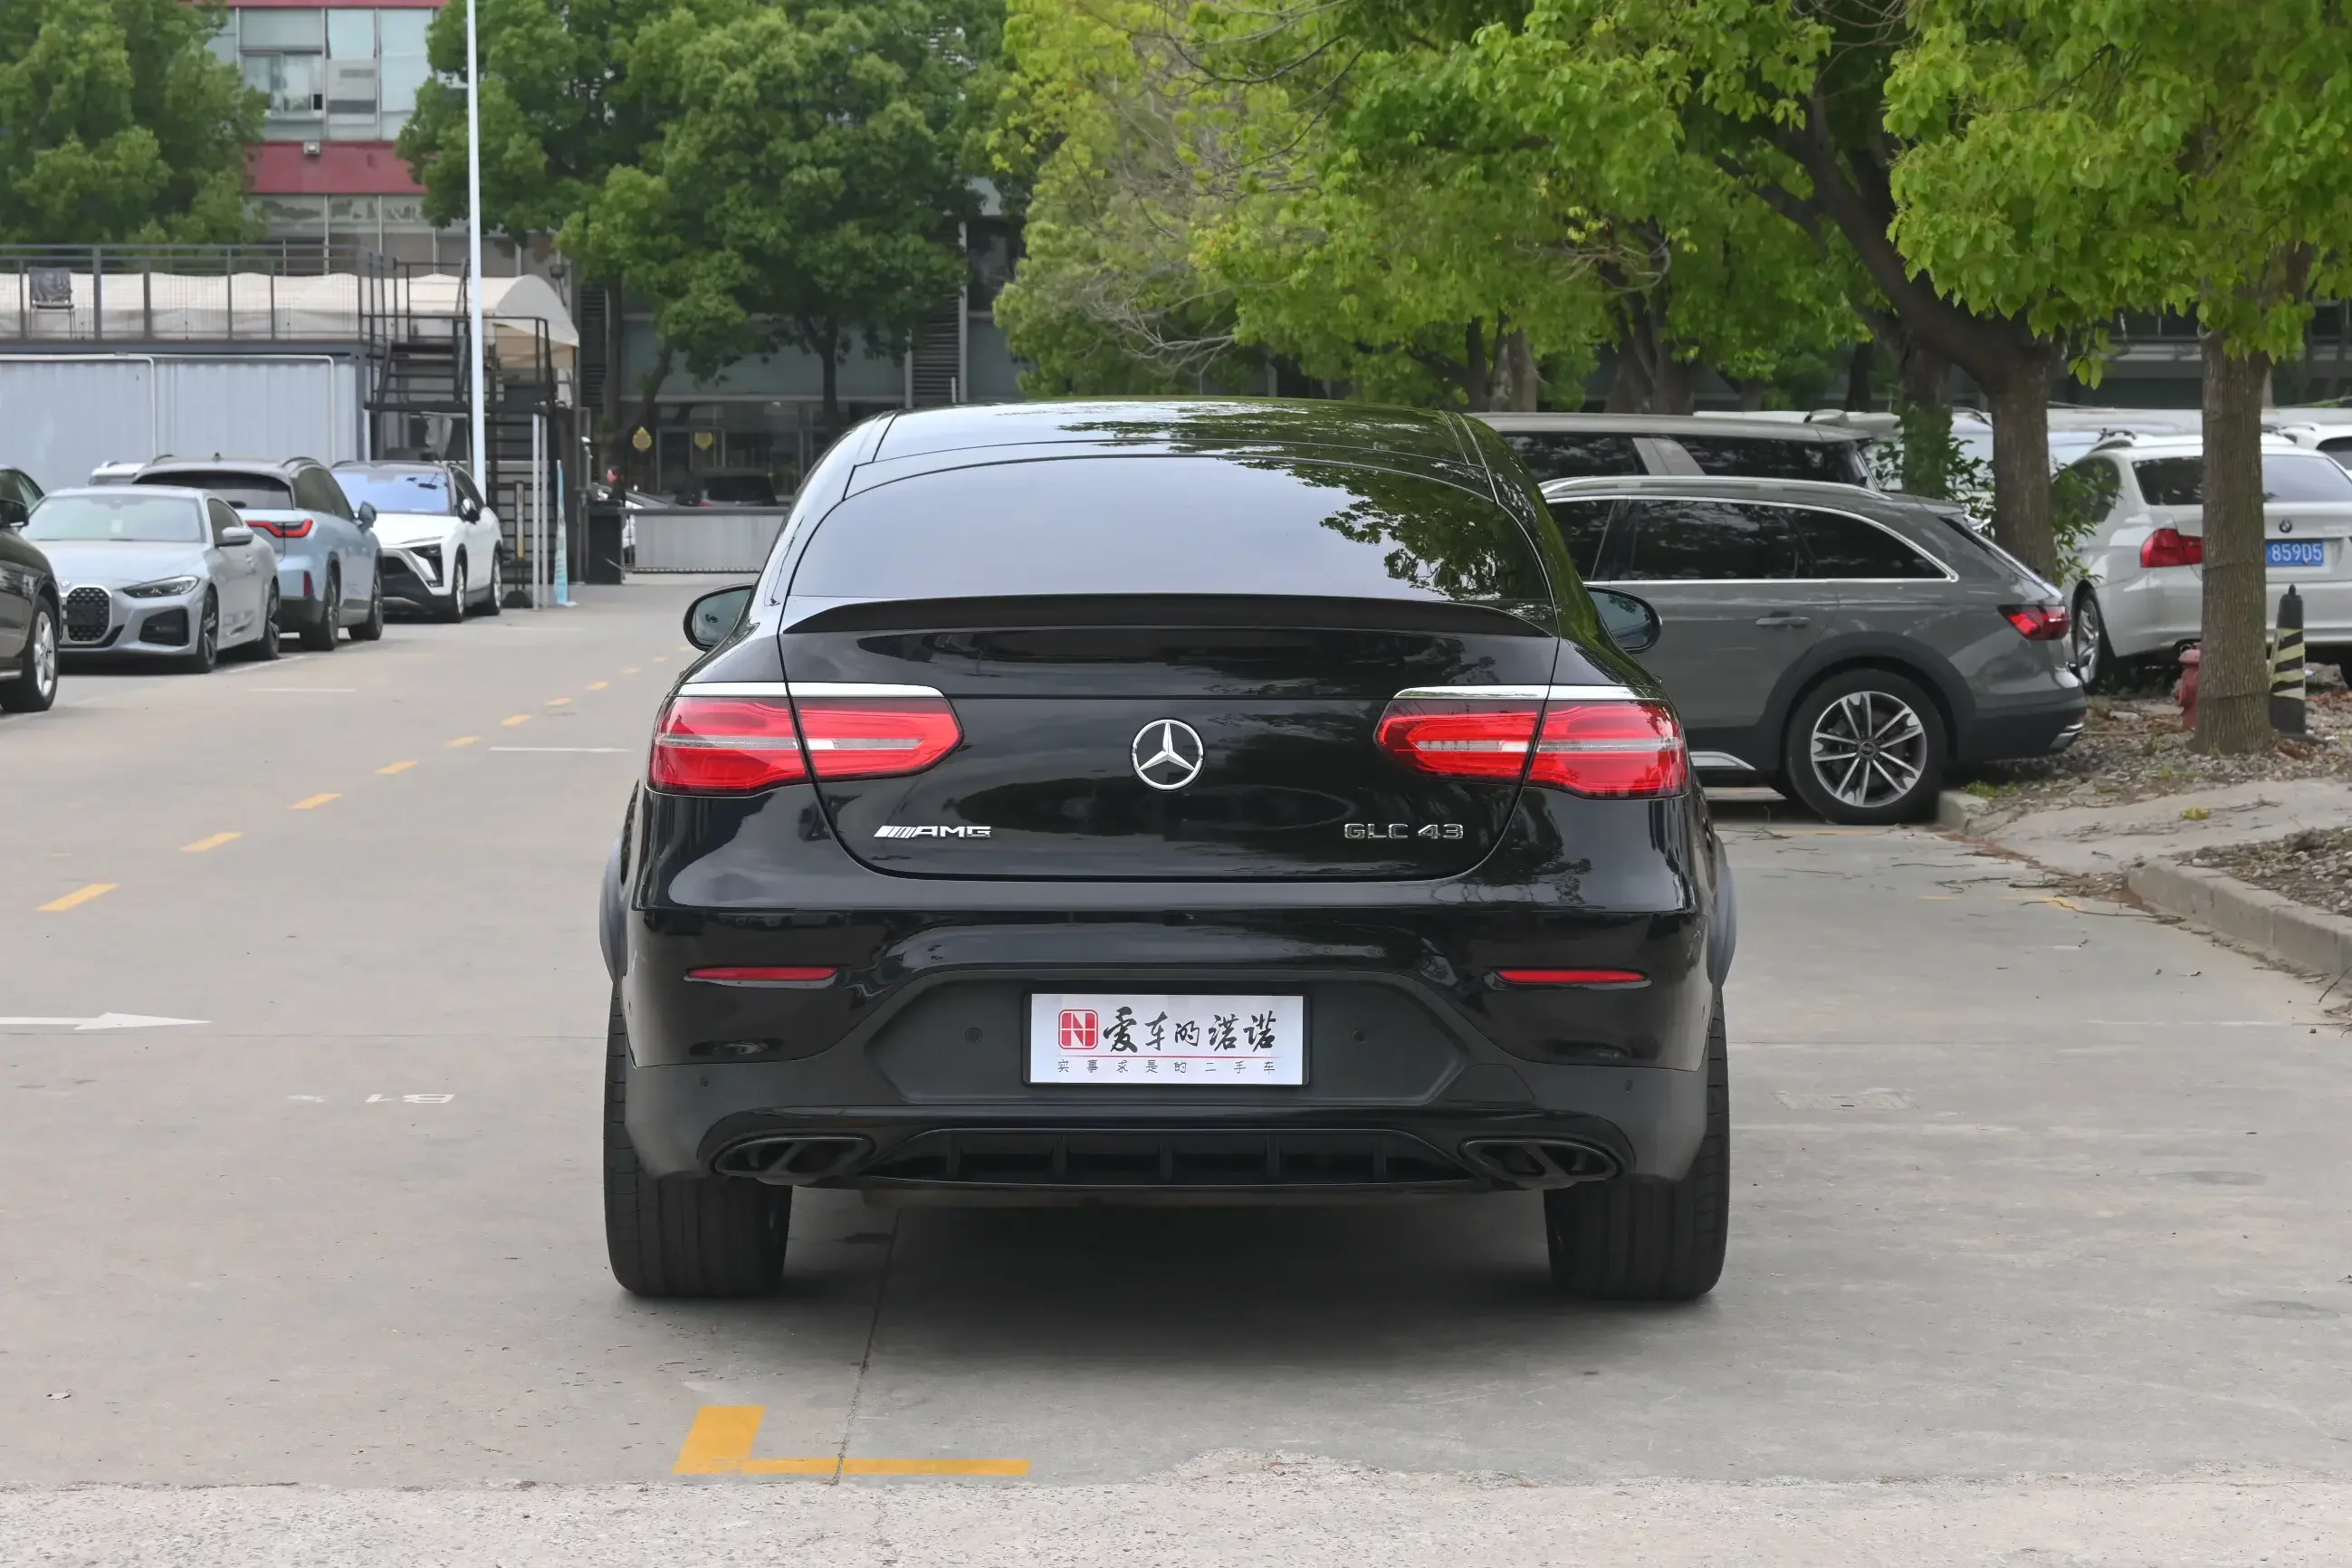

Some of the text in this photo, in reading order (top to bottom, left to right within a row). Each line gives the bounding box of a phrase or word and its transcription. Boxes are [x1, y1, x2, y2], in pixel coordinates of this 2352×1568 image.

[910, 825, 992, 839] AMG
[1343, 822, 1464, 840] GLC 43
[1056, 1059, 1276, 1076] 实事求是的二手车
